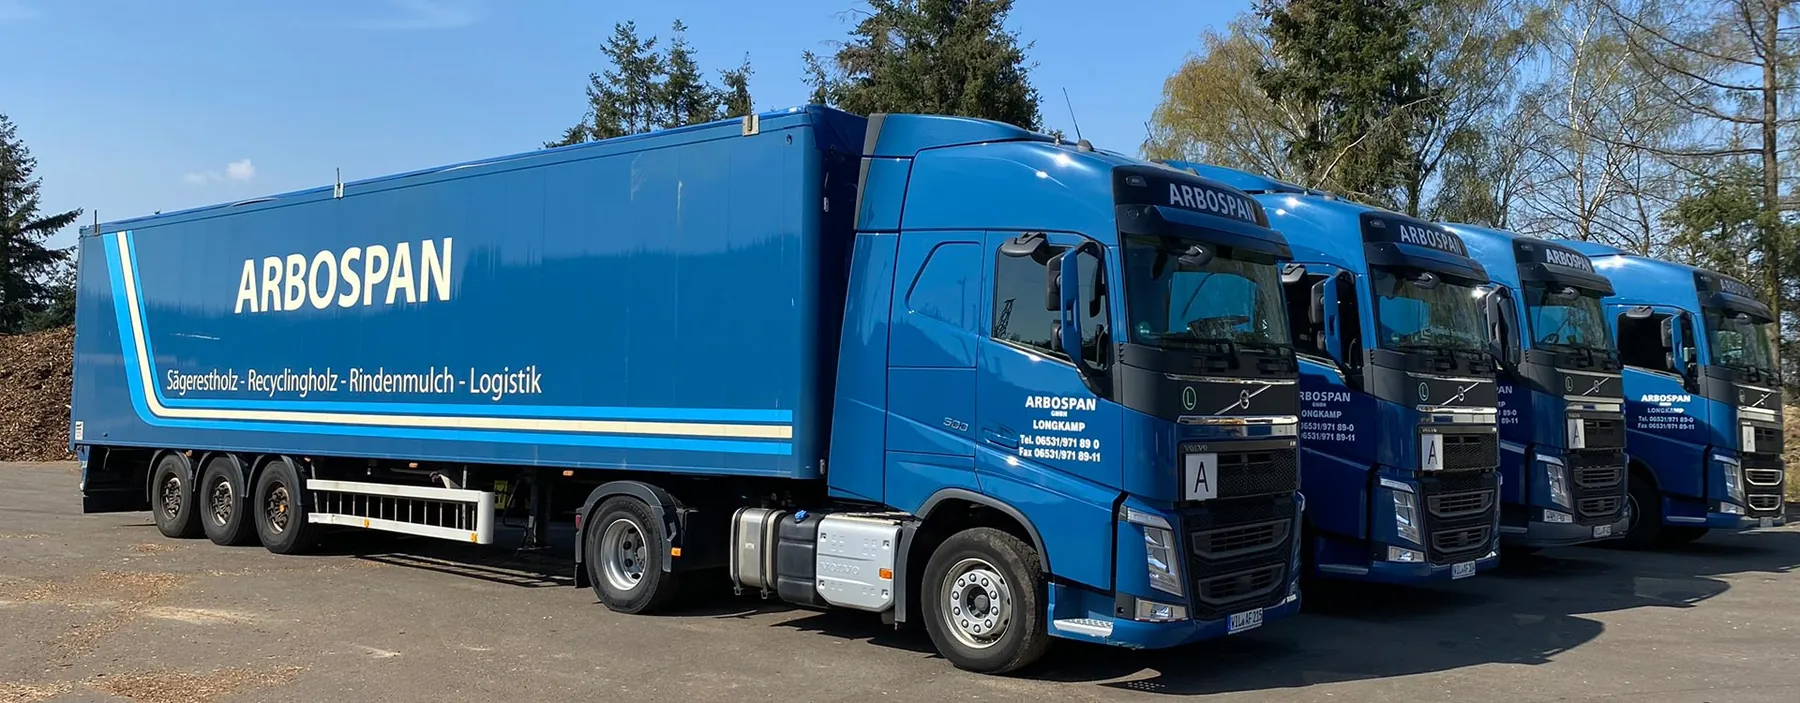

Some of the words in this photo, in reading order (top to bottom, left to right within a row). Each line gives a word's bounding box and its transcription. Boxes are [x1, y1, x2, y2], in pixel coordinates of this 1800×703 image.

[1169, 183, 1257, 223] ARBOSPAN
[1400, 224, 1463, 256] ARBOSPAN
[1545, 248, 1592, 273] ARBOSPAN
[234, 237, 453, 314] ARBOSPAN
[167, 369, 238, 396] Sägerestholz
[248, 368, 338, 398] Recyclingholz
[349, 368, 454, 394] Rindenmulch
[470, 366, 542, 401] Logistik
[1025, 395, 1096, 411] ARBOSPAN
[1187, 393, 1193, 406] L
[1300, 391, 1351, 402] RBOSPAN
[1301, 410, 1342, 418] ONGKAMP
[943, 417, 969, 432] 500
[1033, 419, 1085, 432] LONGKAMP
[1337, 423, 1355, 431] 89-0
[1301, 432, 1334, 440] 6531/971
[1336, 433, 1355, 441] 89-11
[1573, 423, 1581, 444] A
[1020, 434, 1033, 445] Tel.
[1035, 436, 1077, 448] 06531/971
[1079, 440, 1091, 449] 89
[1093, 440, 1100, 450] 0
[1019, 448, 1033, 457] Fax
[1034, 449, 1076, 461] 06531/971
[1078, 452, 1101, 462] 89-11
[1428, 440, 1438, 465] A
[1194, 461, 1209, 493] A
[819, 561, 860, 576] VOLVO
